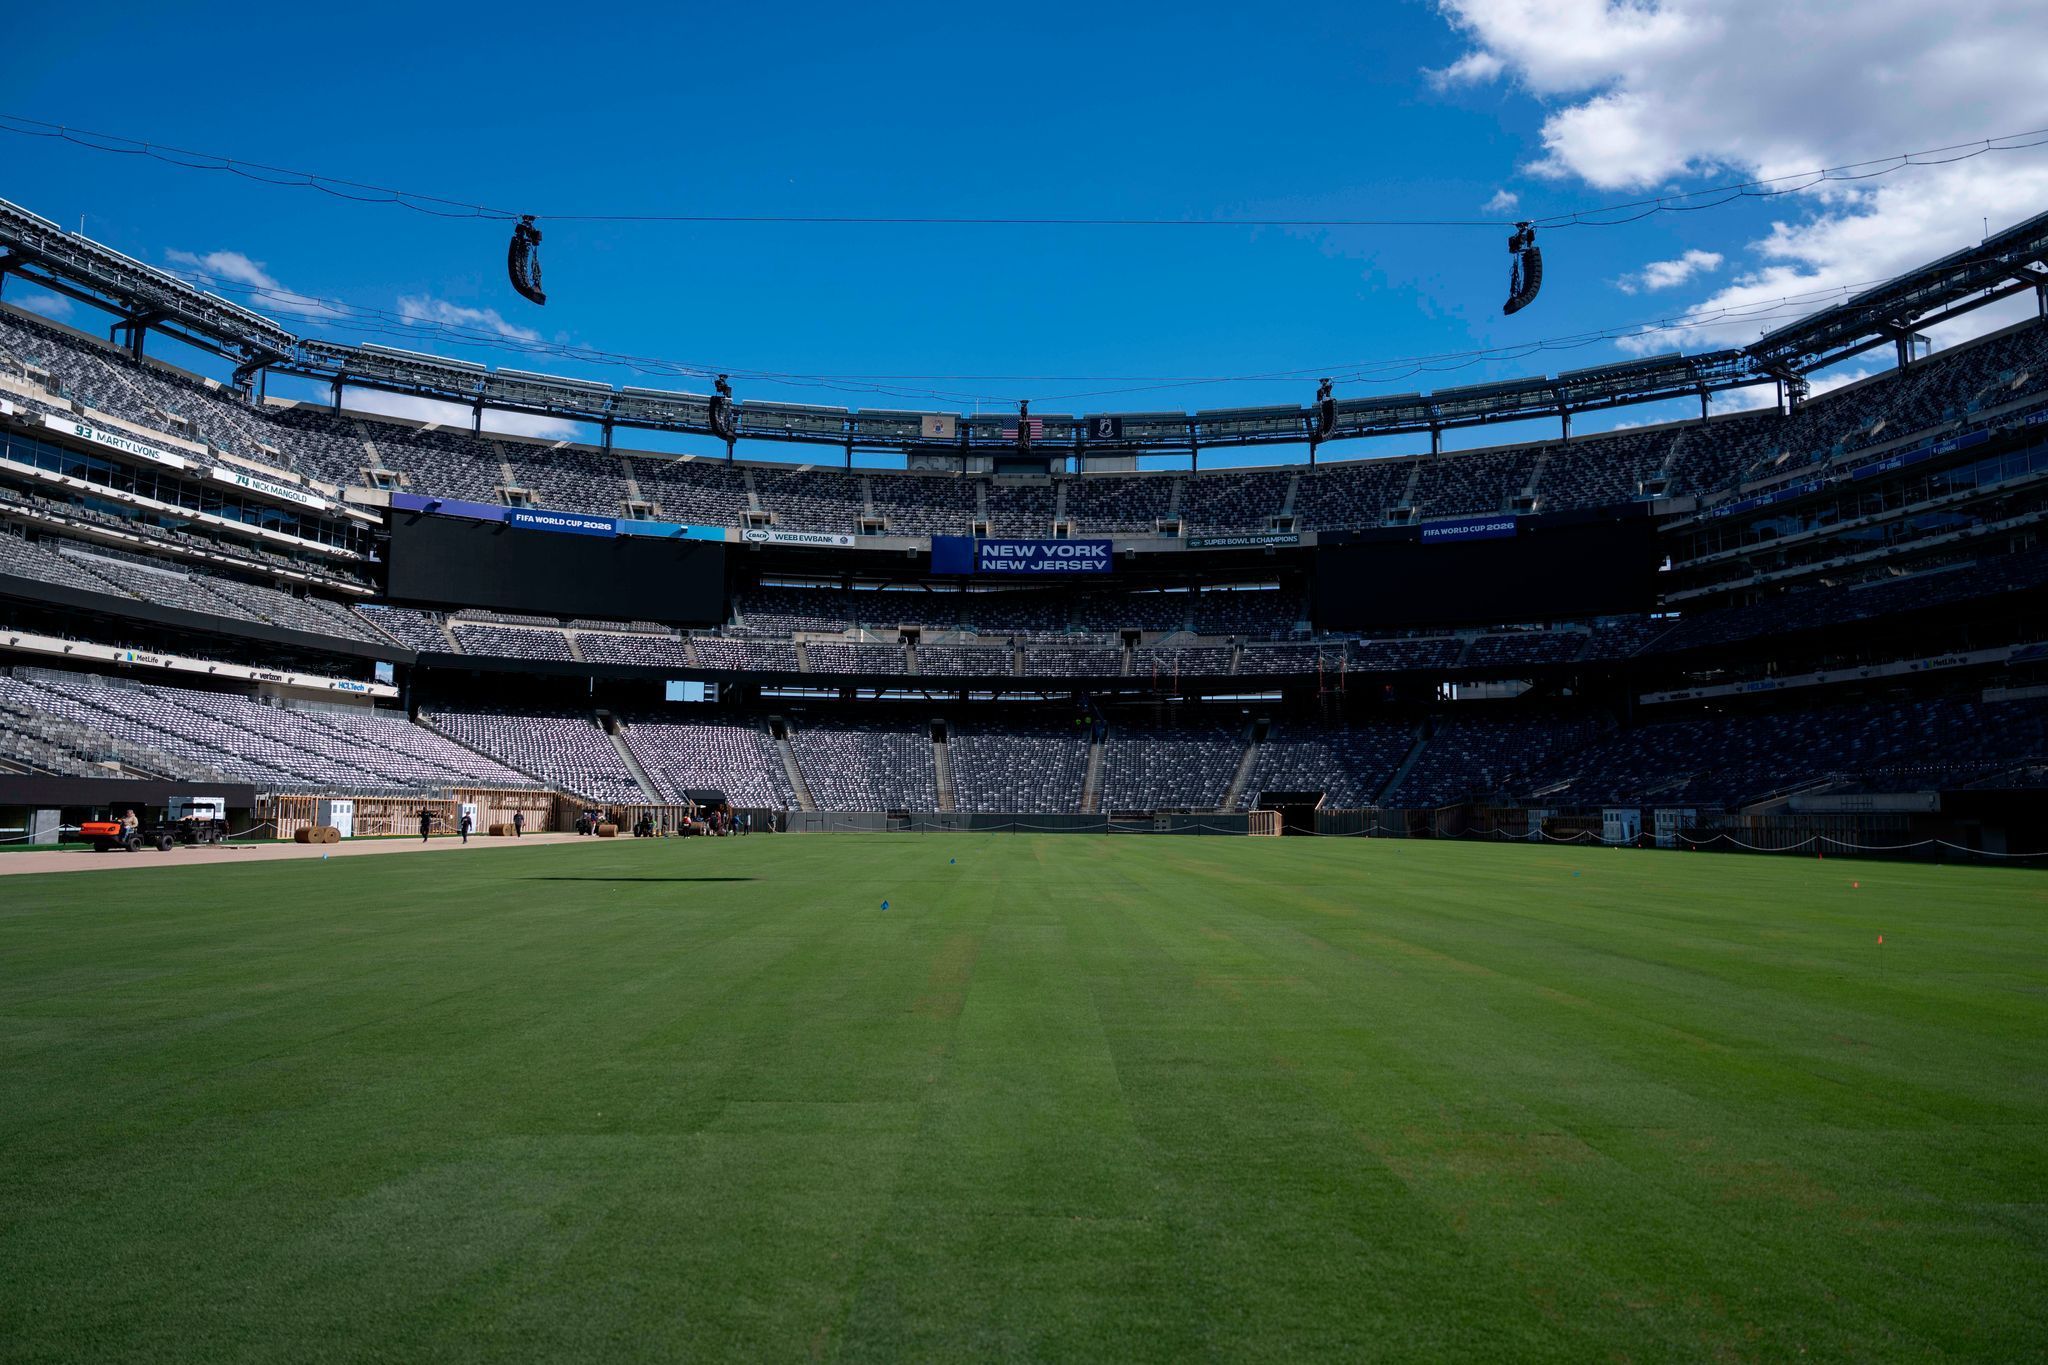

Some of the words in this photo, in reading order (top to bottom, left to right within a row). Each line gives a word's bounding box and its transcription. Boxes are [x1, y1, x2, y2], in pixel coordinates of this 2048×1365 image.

[74, 424, 93, 439] 93
[96, 432, 132, 450] MARTY
[133, 443, 160, 459] LYONS
[235, 474, 249, 487] 74
[252, 480, 270, 491] NICK
[270, 486, 307, 503] MANGOLD
[516, 513, 534, 523] FIFA
[535, 516, 565, 526] WORLD
[566, 519, 582, 527] CUP
[583, 521, 612, 531] 2026
[1423, 529, 1440, 537] FIFA
[1441, 526, 1469, 535] WORLD
[1469, 524, 1486, 532] CUP
[1486, 522, 1514, 531] 2026
[774, 533, 798, 541] WEEB
[799, 535, 833, 543] EWBANK
[1203, 538, 1226, 546] SUPER
[1227, 537, 1249, 545] BOWL
[1256, 535, 1298, 544] CHAMPIONS
[982, 545, 1036, 557] NEW
[1041, 545, 1107, 557] YORK
[982, 560, 1027, 570] NEW
[1030, 560, 1107, 571] JERSEY
[136, 654, 159, 664] MetLife
[259, 672, 282, 682] verizon
